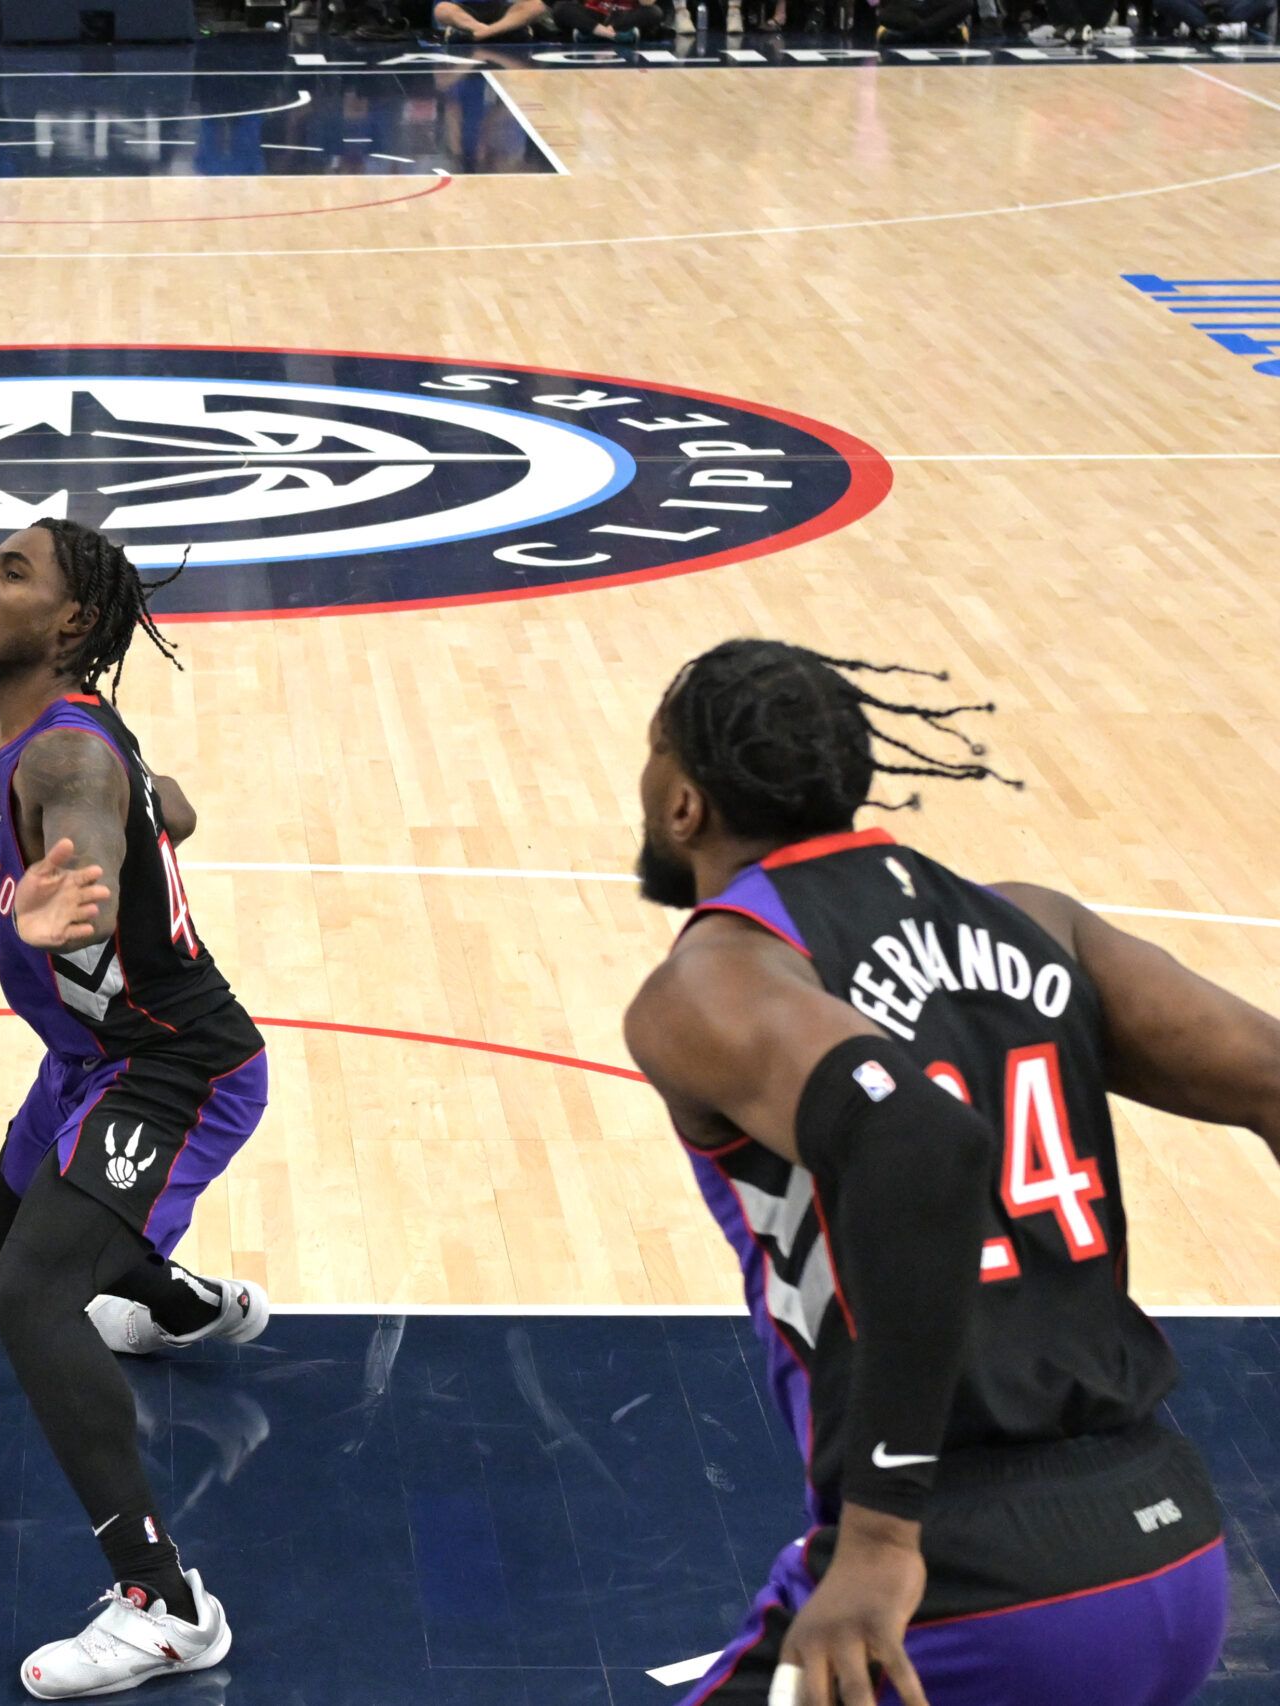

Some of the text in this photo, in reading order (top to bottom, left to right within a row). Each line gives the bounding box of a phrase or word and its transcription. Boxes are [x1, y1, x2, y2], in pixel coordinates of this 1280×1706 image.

[288, 52, 487, 65] LA
[420, 374, 793, 567] CLIPPERS
[924, 1041, 1108, 1283] 4
